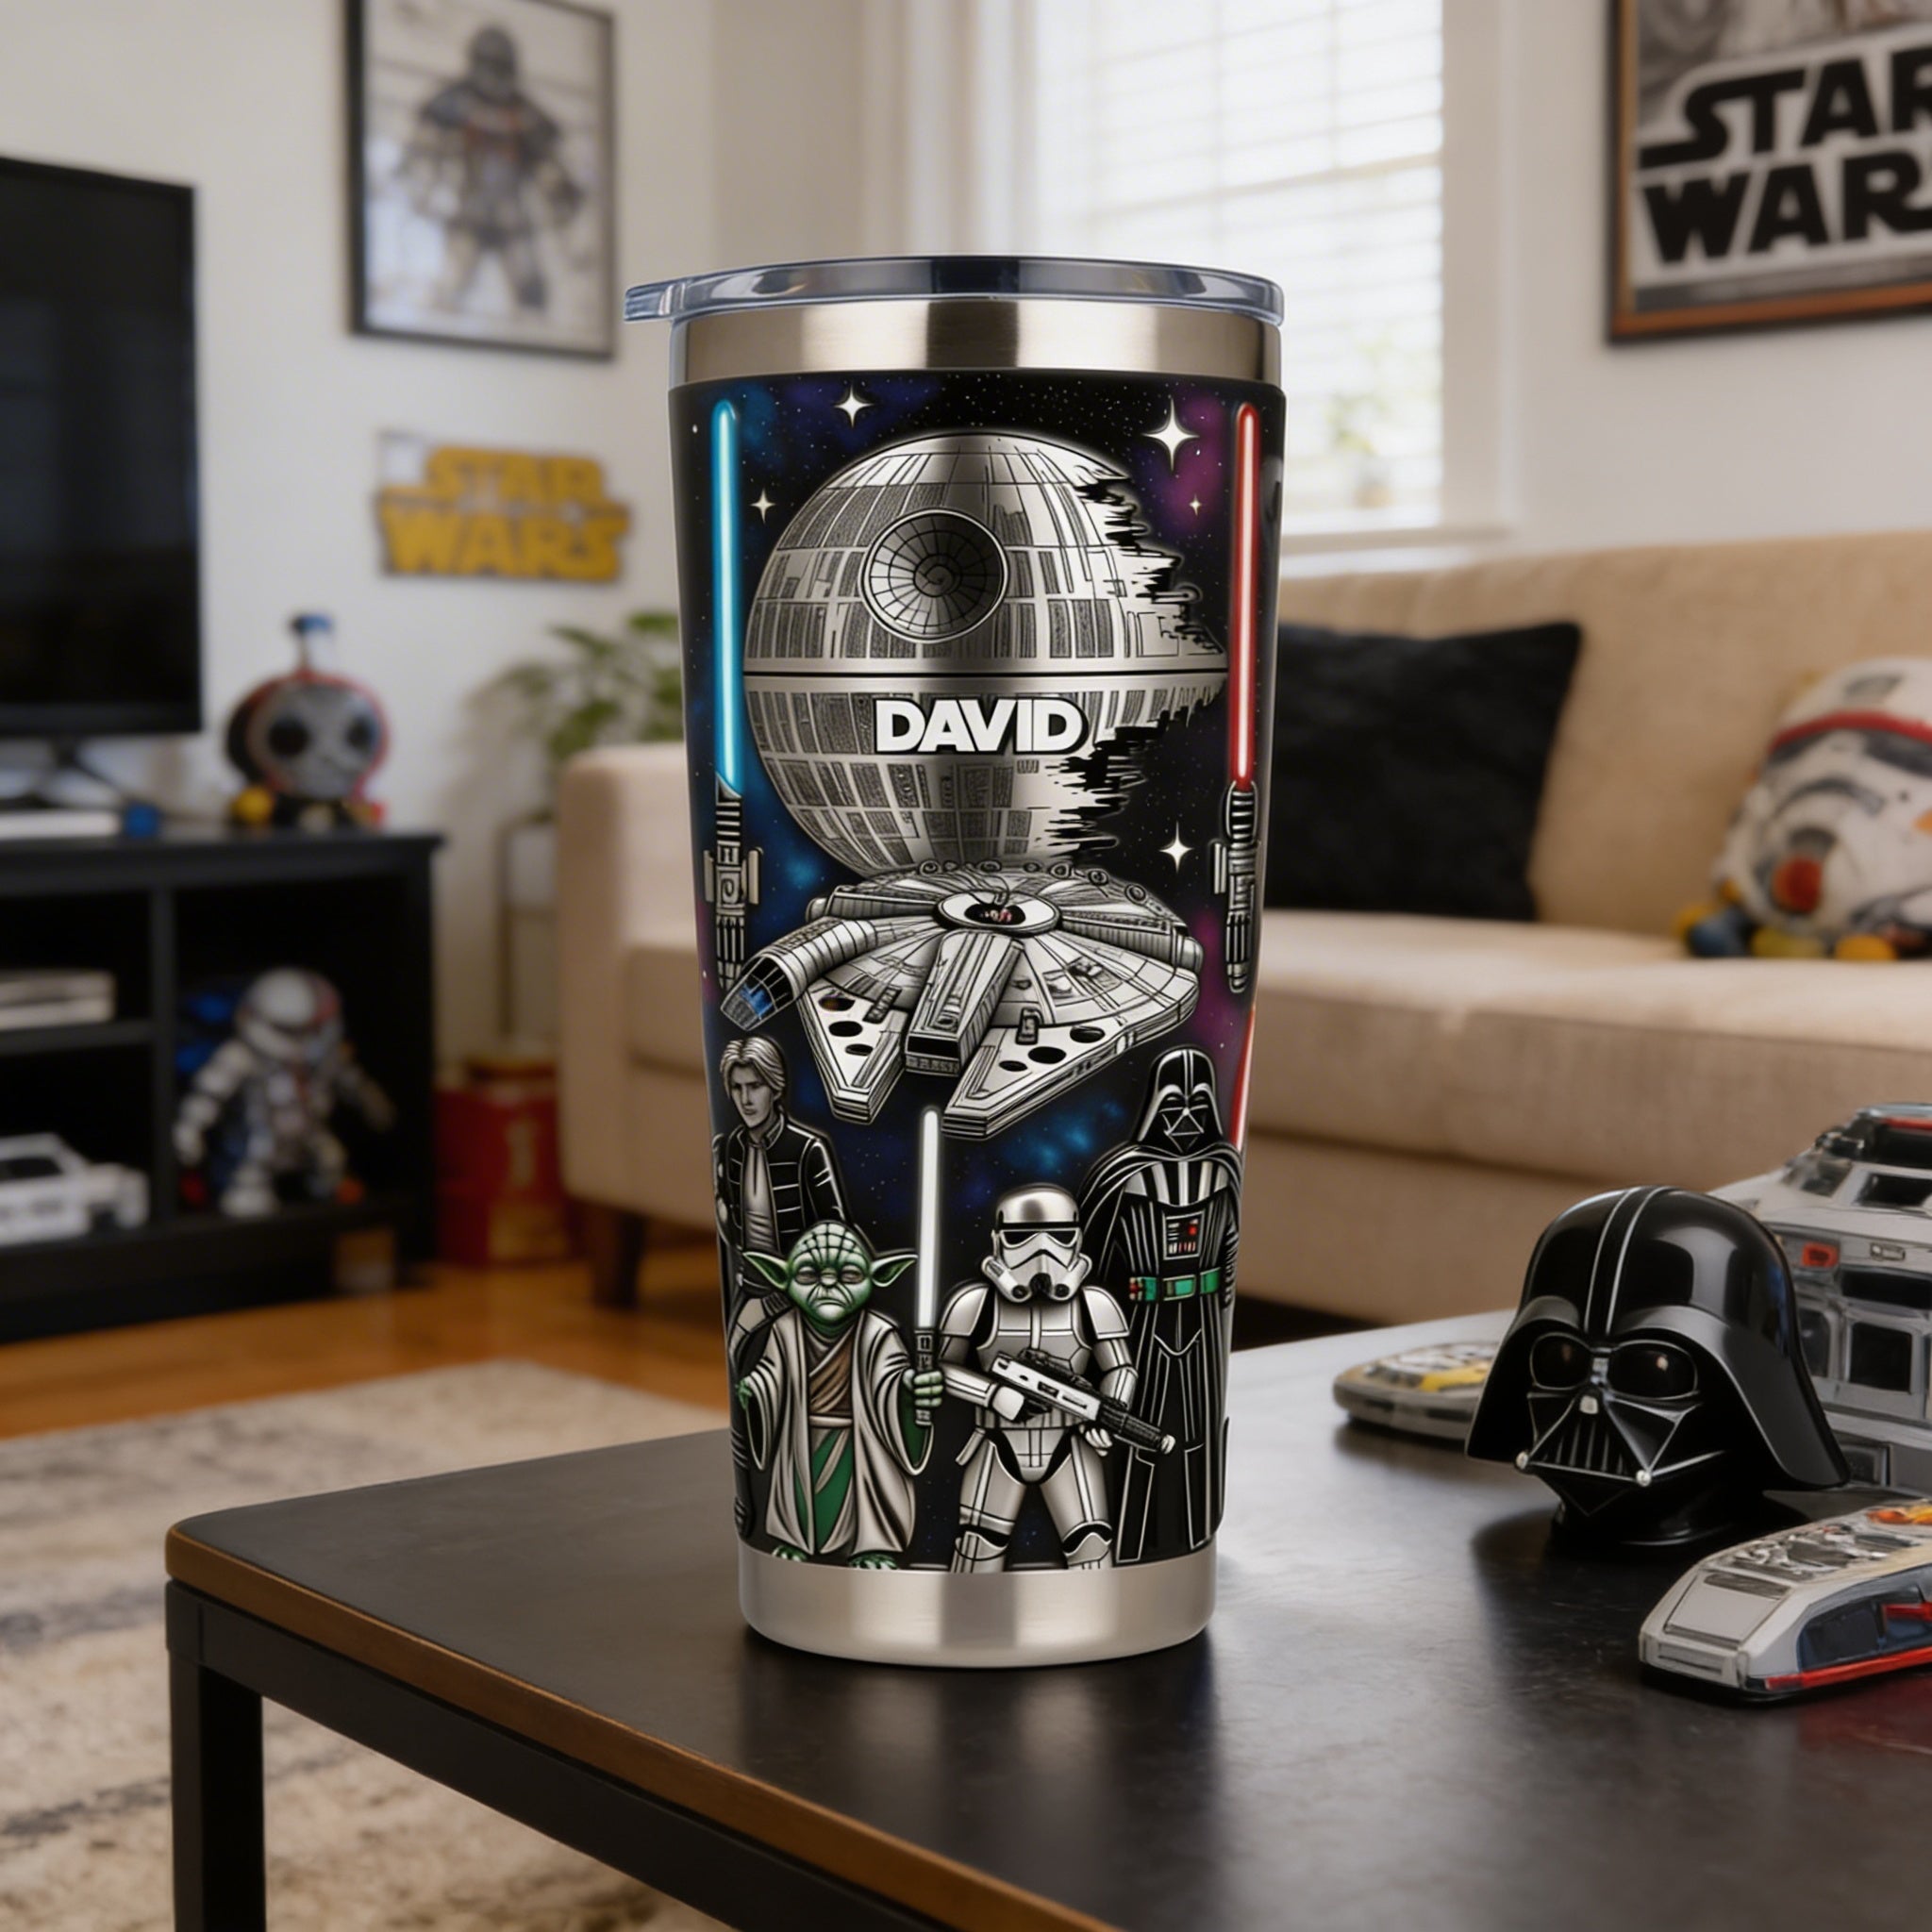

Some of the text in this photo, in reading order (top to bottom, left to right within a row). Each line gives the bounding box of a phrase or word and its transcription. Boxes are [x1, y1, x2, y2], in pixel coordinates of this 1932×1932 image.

[379, 446, 606, 506] STAR
[378, 500, 629, 580] WARS
[874, 697, 1085, 753] DAVID
